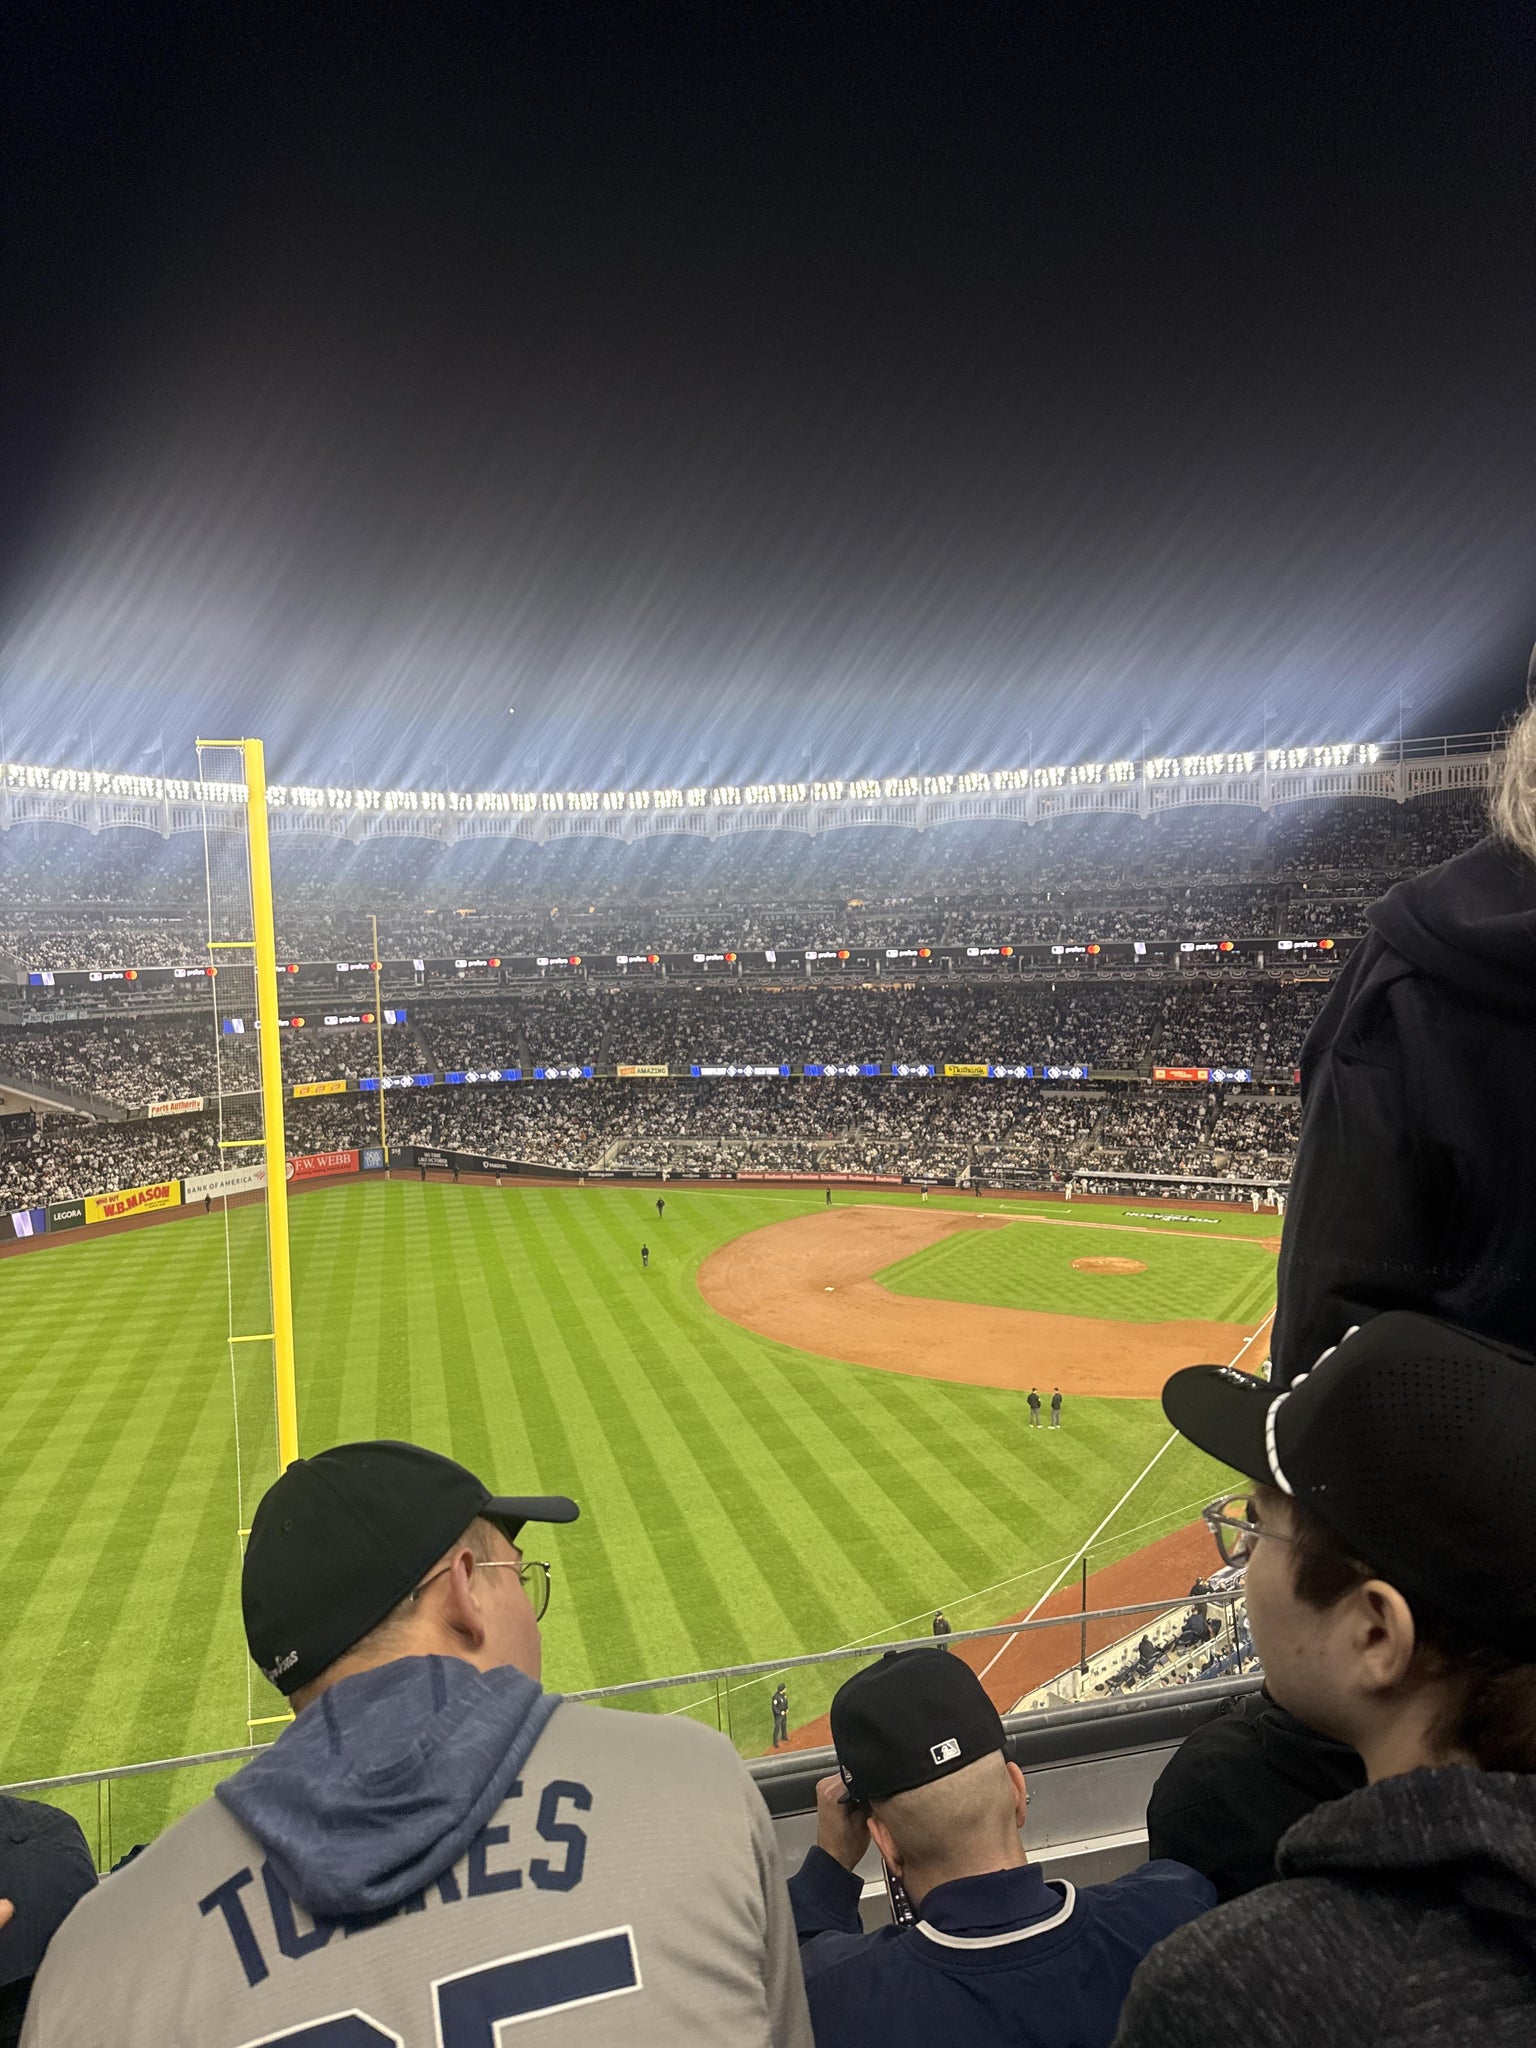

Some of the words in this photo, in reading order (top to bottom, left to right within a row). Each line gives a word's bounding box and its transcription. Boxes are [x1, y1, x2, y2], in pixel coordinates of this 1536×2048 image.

[637, 1067, 666, 1075] AMAZING
[152, 1104, 169, 1113] Parts
[170, 1100, 201, 1110] Authority
[316, 1153, 351, 1167] WEBB
[186, 1184, 207, 1195] BANK
[208, 1182, 219, 1190] OF
[219, 1176, 253, 1189] AMERICA
[53, 1209, 82, 1221] LEGORA
[199, 1779, 594, 1988] TOES
